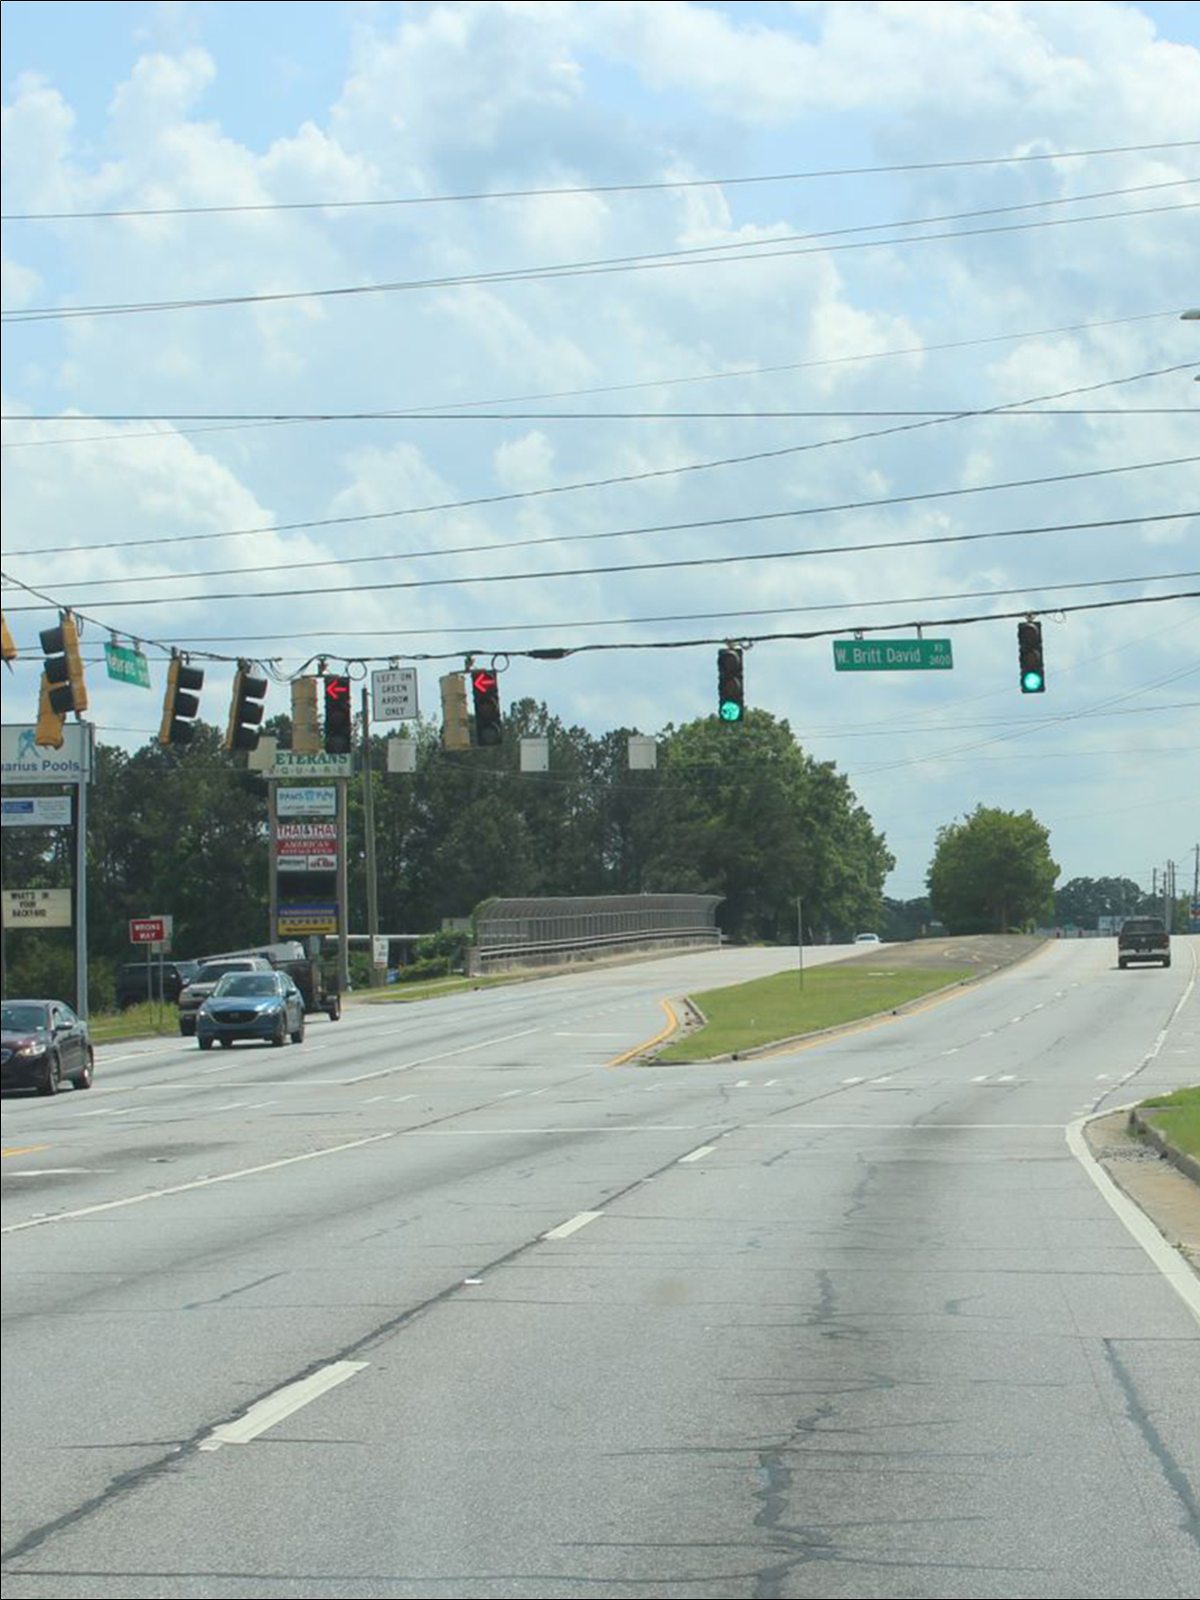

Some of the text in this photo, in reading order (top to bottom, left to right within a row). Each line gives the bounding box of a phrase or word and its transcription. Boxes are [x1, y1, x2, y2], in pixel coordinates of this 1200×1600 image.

[835, 647, 921, 664] W. Britt David
[376, 672, 411, 682] LEFT ON
[382, 684, 407, 693] GREEN
[382, 695, 408, 705] ARROW
[385, 707, 404, 716] ONLY
[275, 752, 348, 765] ETERANS
[42, 760, 80, 771] Pools
